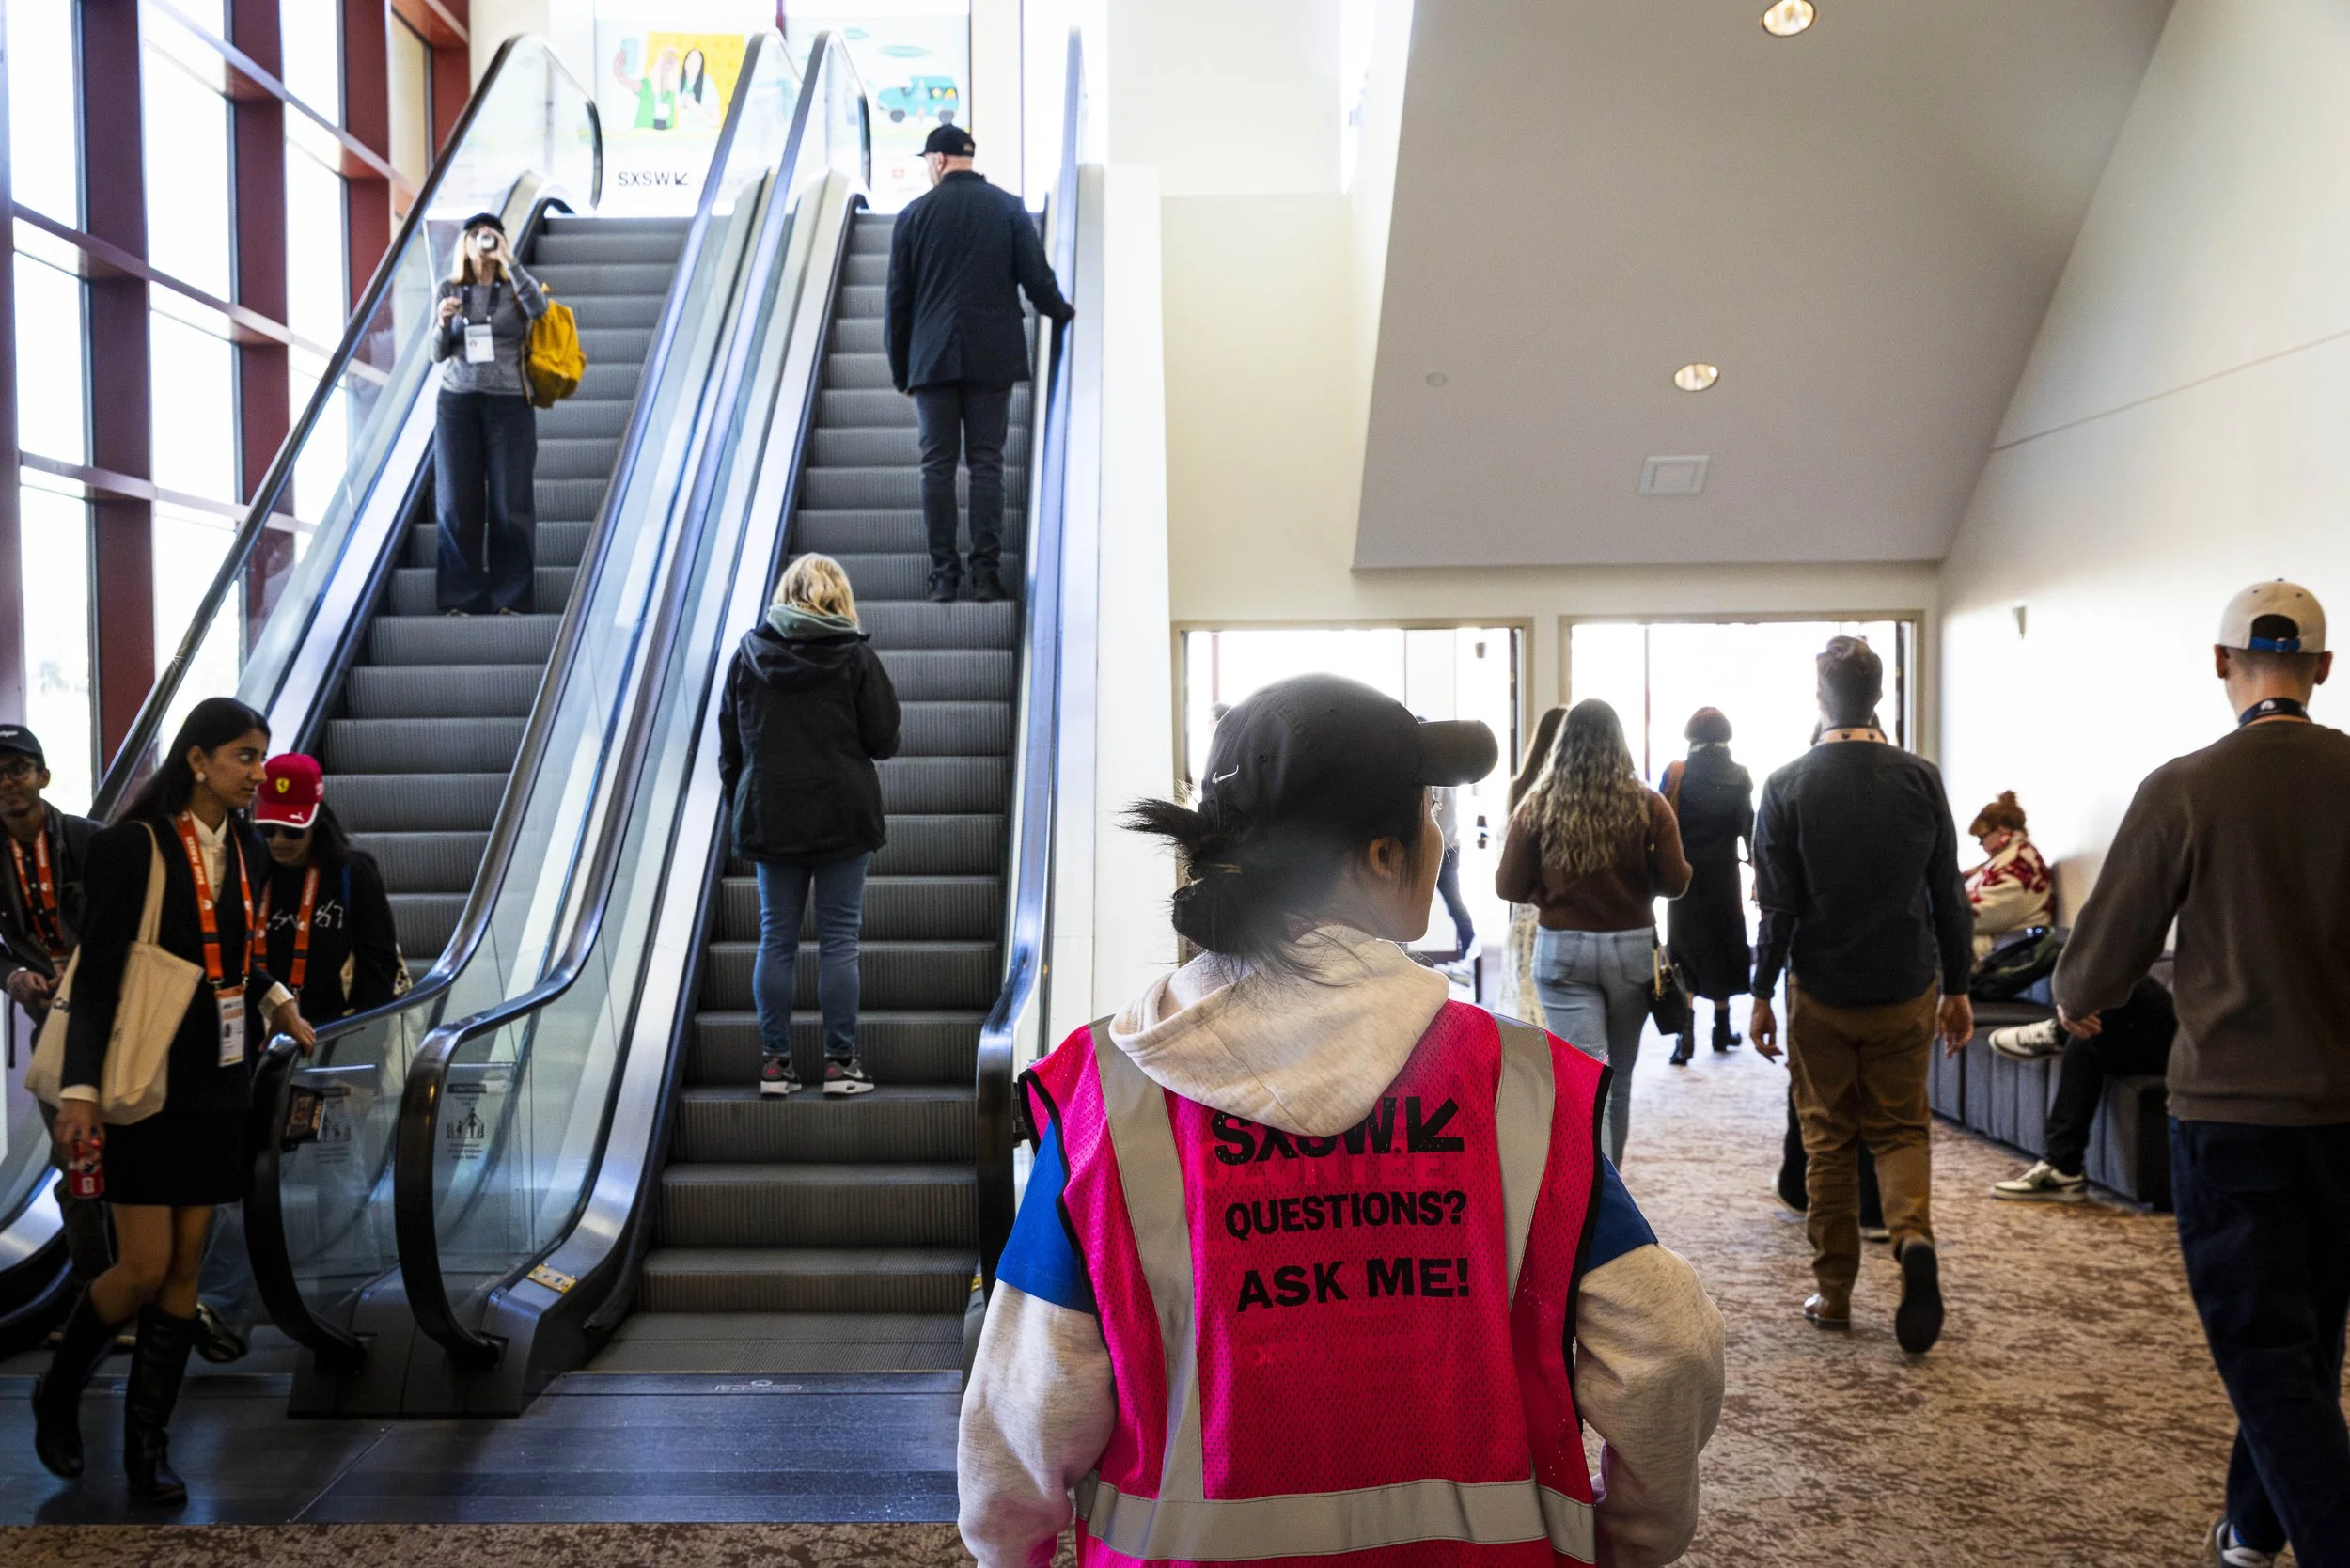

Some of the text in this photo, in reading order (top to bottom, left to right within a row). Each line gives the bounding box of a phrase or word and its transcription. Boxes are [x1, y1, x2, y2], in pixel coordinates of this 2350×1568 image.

[619, 171, 670, 186] SXSW
[1225, 1190, 1467, 1241] QUESTIONS?
[1237, 1258, 1469, 1312] ASK ME!
